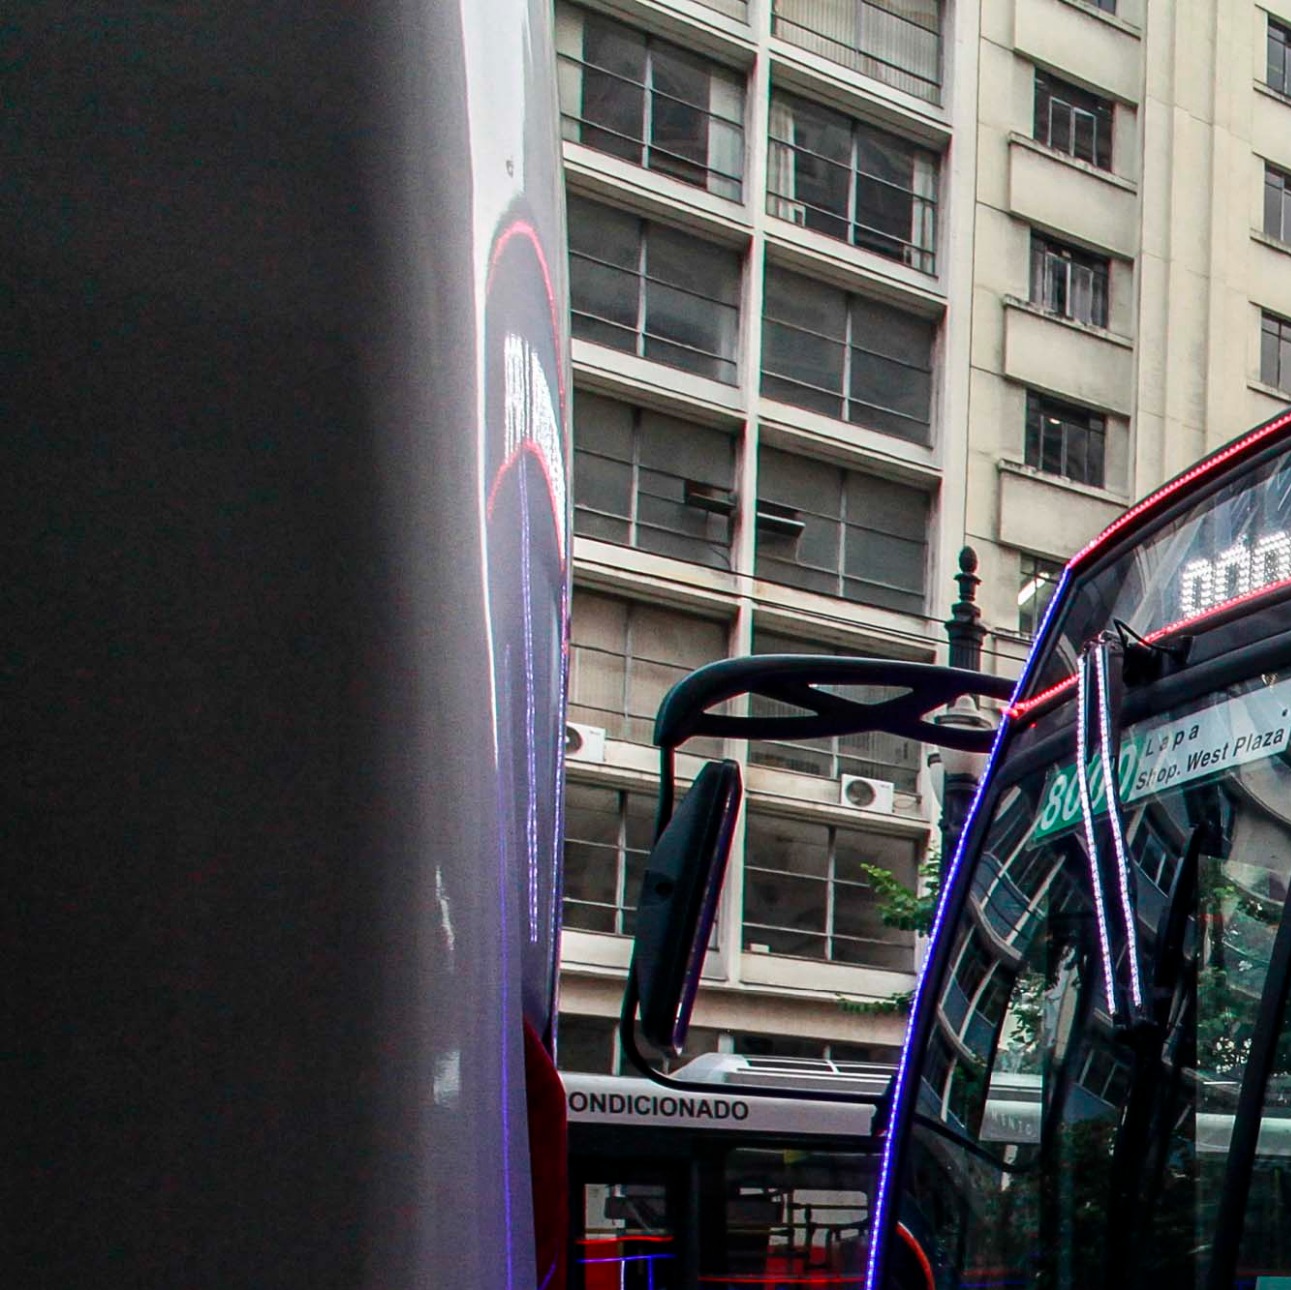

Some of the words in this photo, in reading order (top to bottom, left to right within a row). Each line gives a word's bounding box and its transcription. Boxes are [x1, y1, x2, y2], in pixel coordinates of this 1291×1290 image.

[1136, 766, 1181, 791] Shop.
[1186, 743, 1229, 773] West
[1233, 727, 1285, 757] Plaza
[1146, 724, 1199, 757] Lapa
